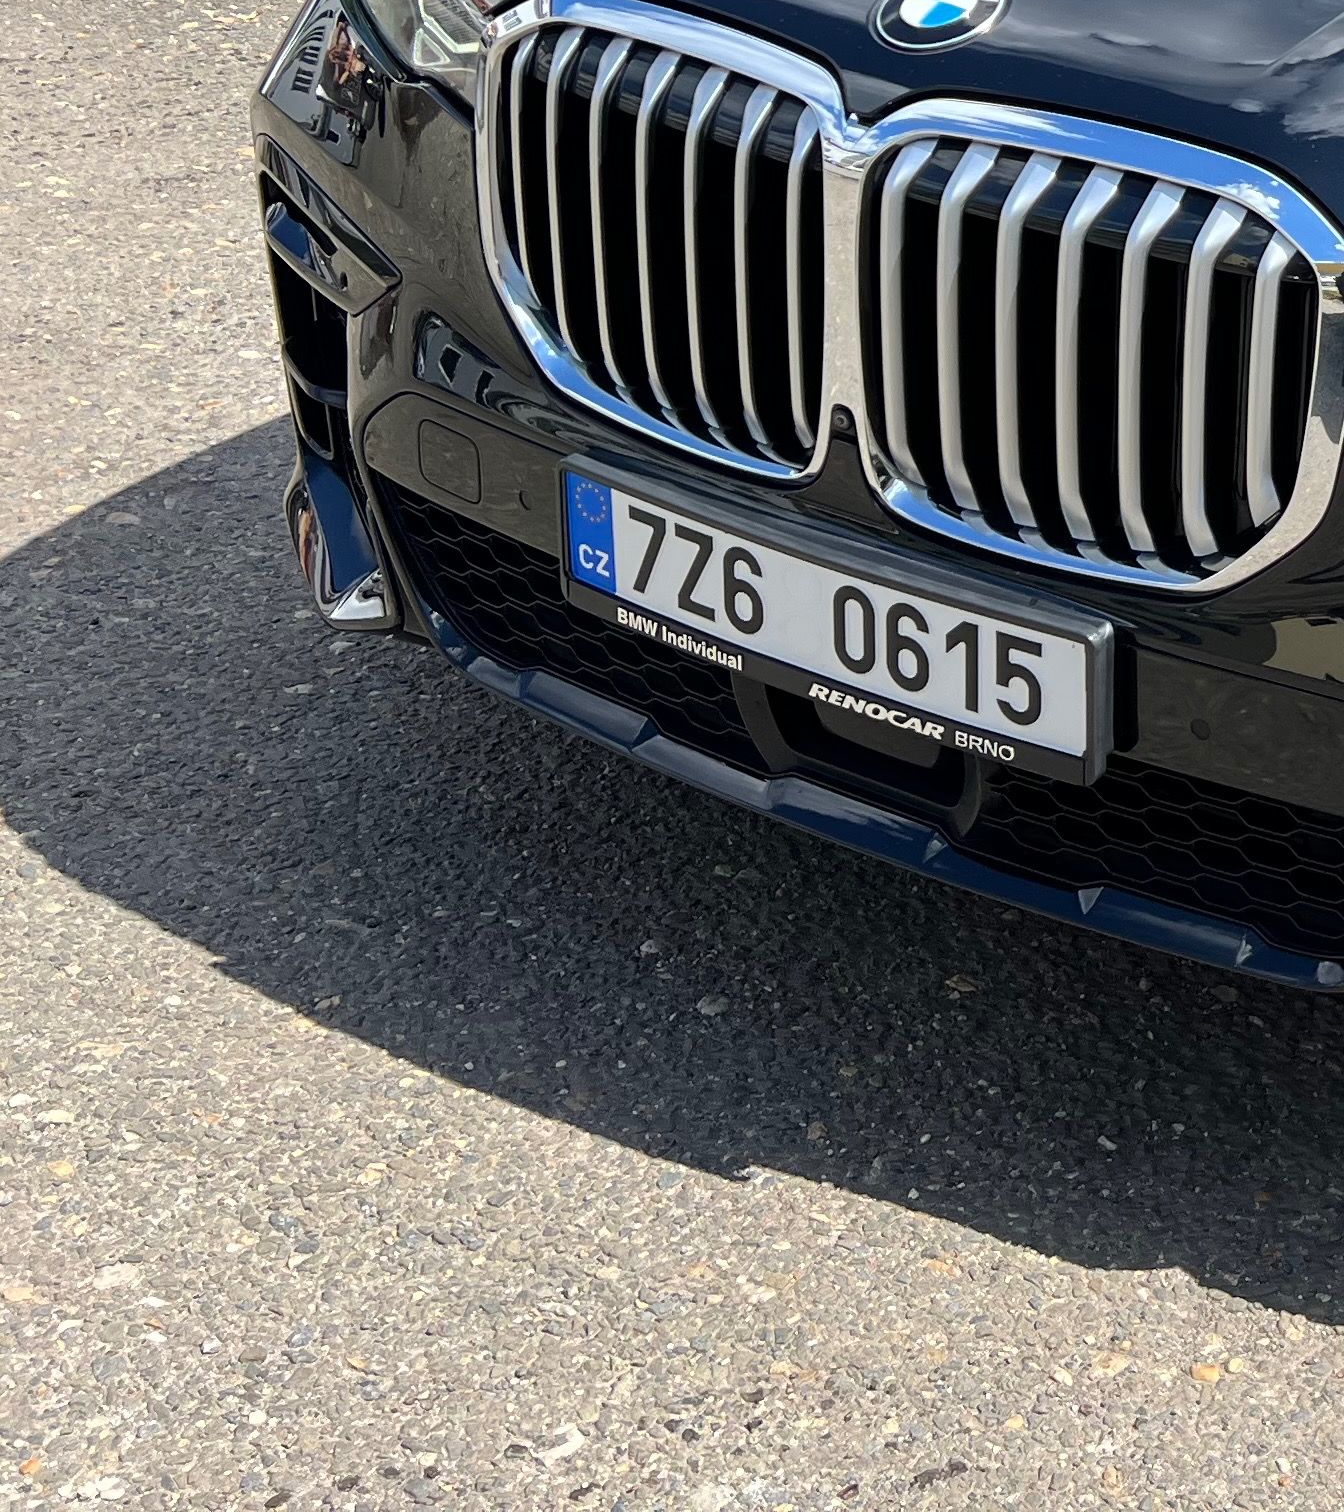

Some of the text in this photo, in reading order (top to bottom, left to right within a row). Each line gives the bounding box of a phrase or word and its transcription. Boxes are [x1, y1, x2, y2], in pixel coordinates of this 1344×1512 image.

[577, 542, 611, 579] CZ
[616, 606, 744, 672] BMW Individual
[627, 503, 1043, 728] 7Z6 0615
[807, 682, 1016, 762] RENOCAR BRNO
